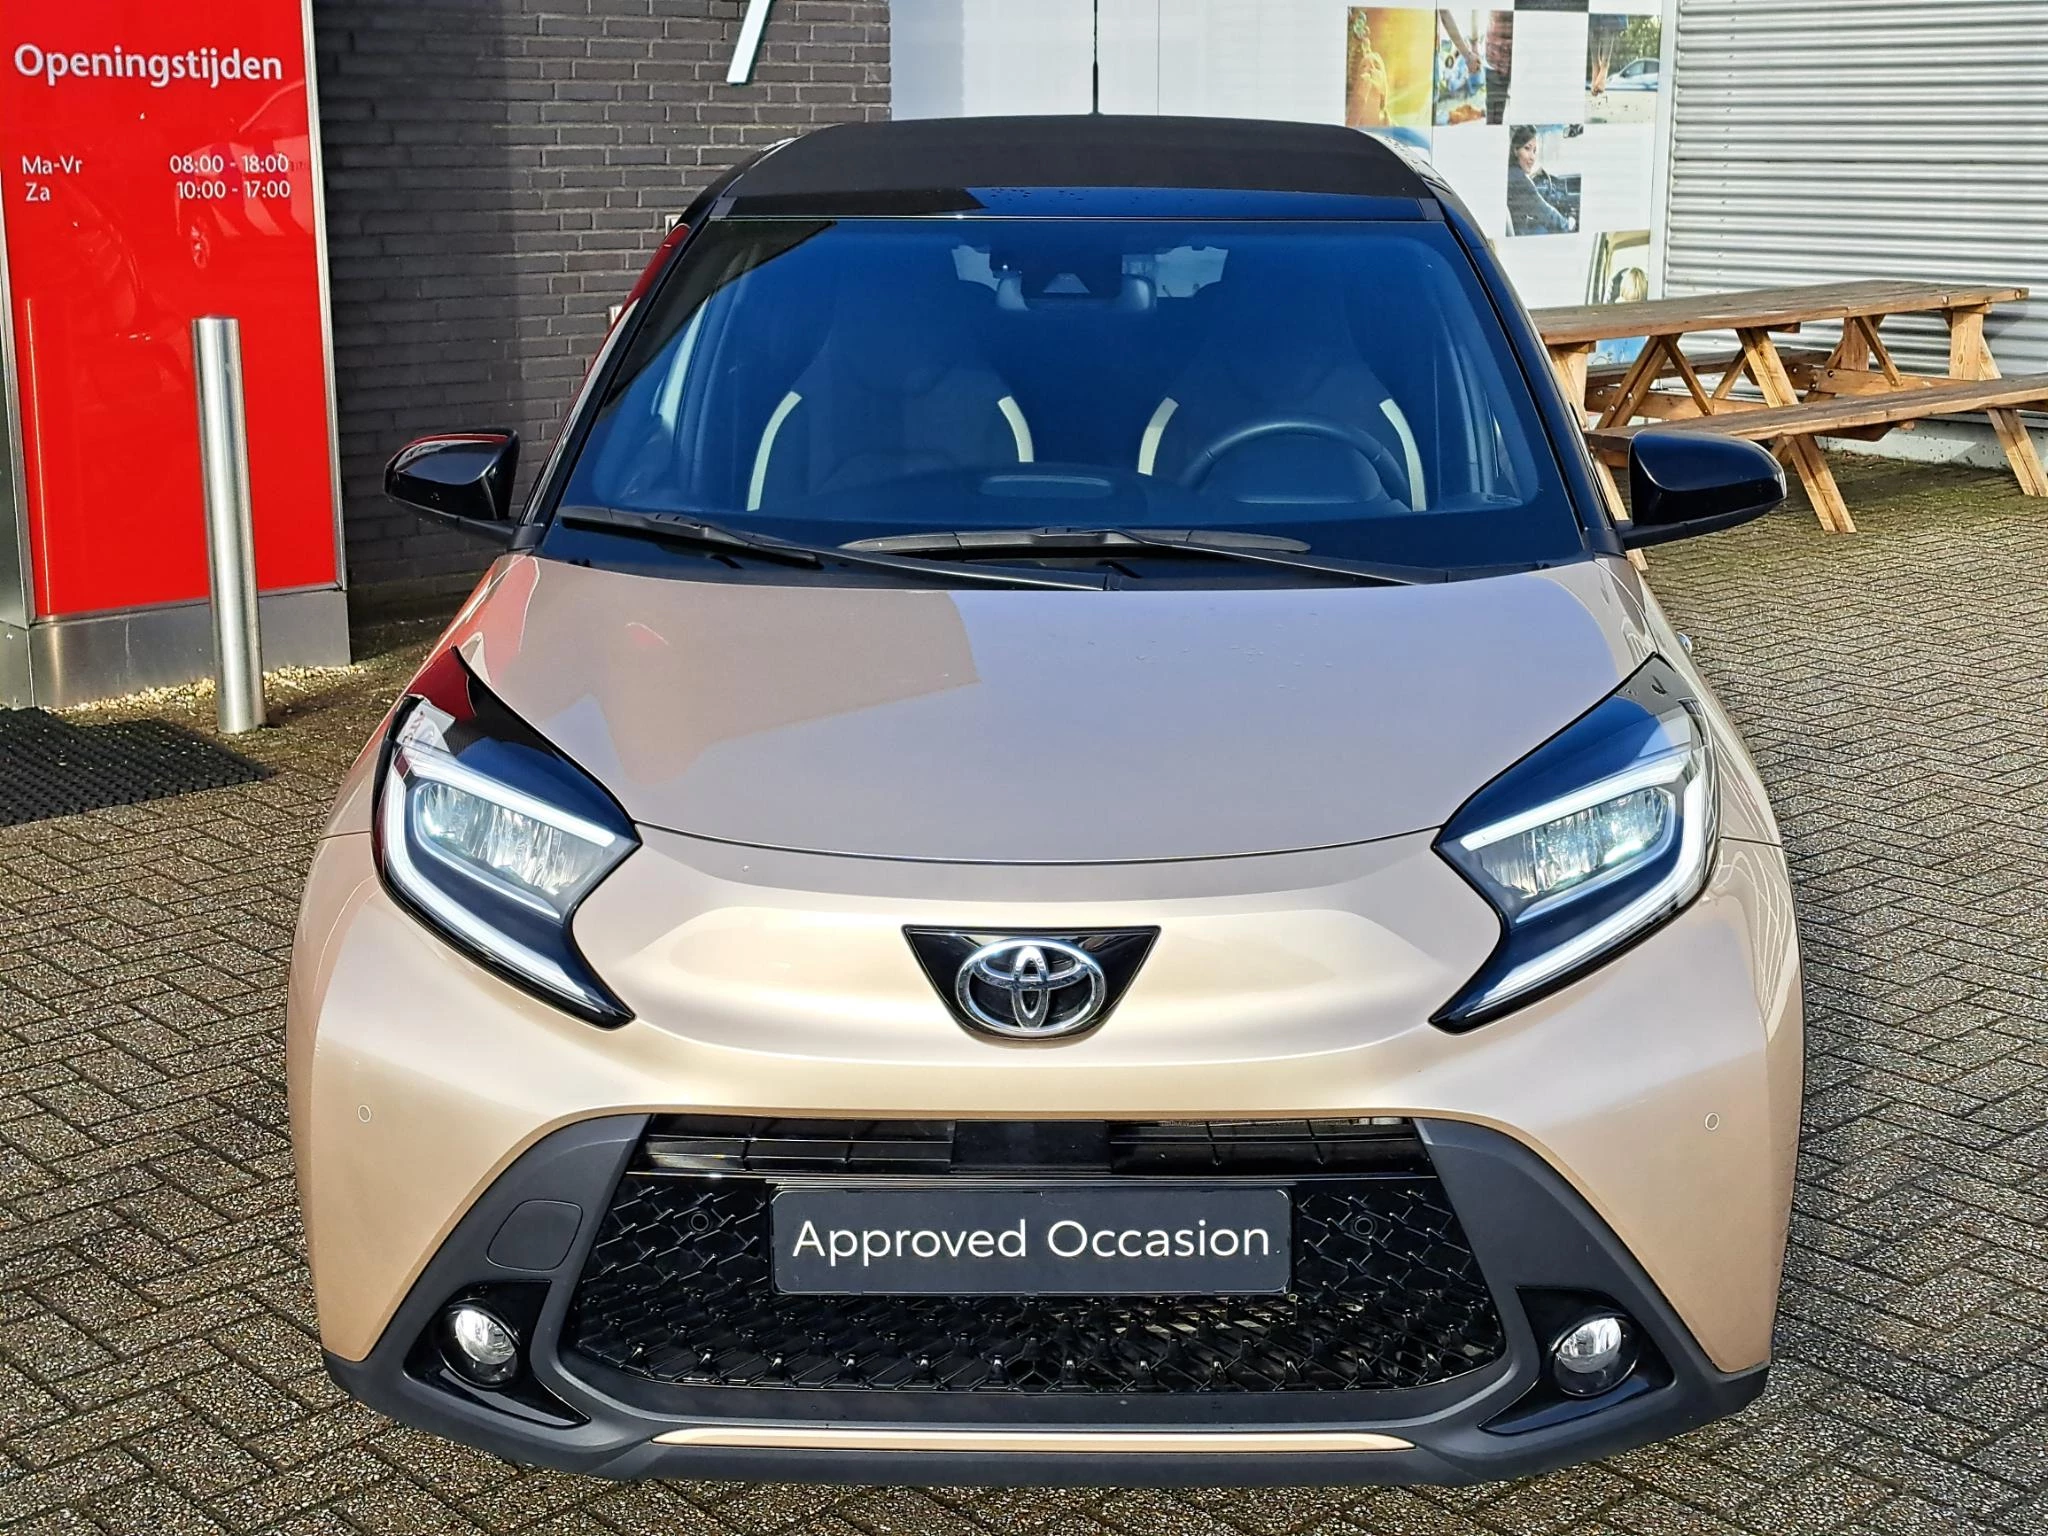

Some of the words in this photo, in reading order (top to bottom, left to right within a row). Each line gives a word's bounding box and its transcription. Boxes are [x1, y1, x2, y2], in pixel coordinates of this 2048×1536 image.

[14, 43, 282, 88] Openingstijden
[21, 155, 83, 175] Ma-Vr
[169, 154, 224, 174] 08:00
[241, 153, 289, 173] 18:00
[25, 182, 51, 202] Za
[176, 180, 226, 199] 10:00
[244, 180, 291, 199] 17:00
[792, 1218, 1027, 1267] Approved
[1046, 1218, 1270, 1258] Occasion
